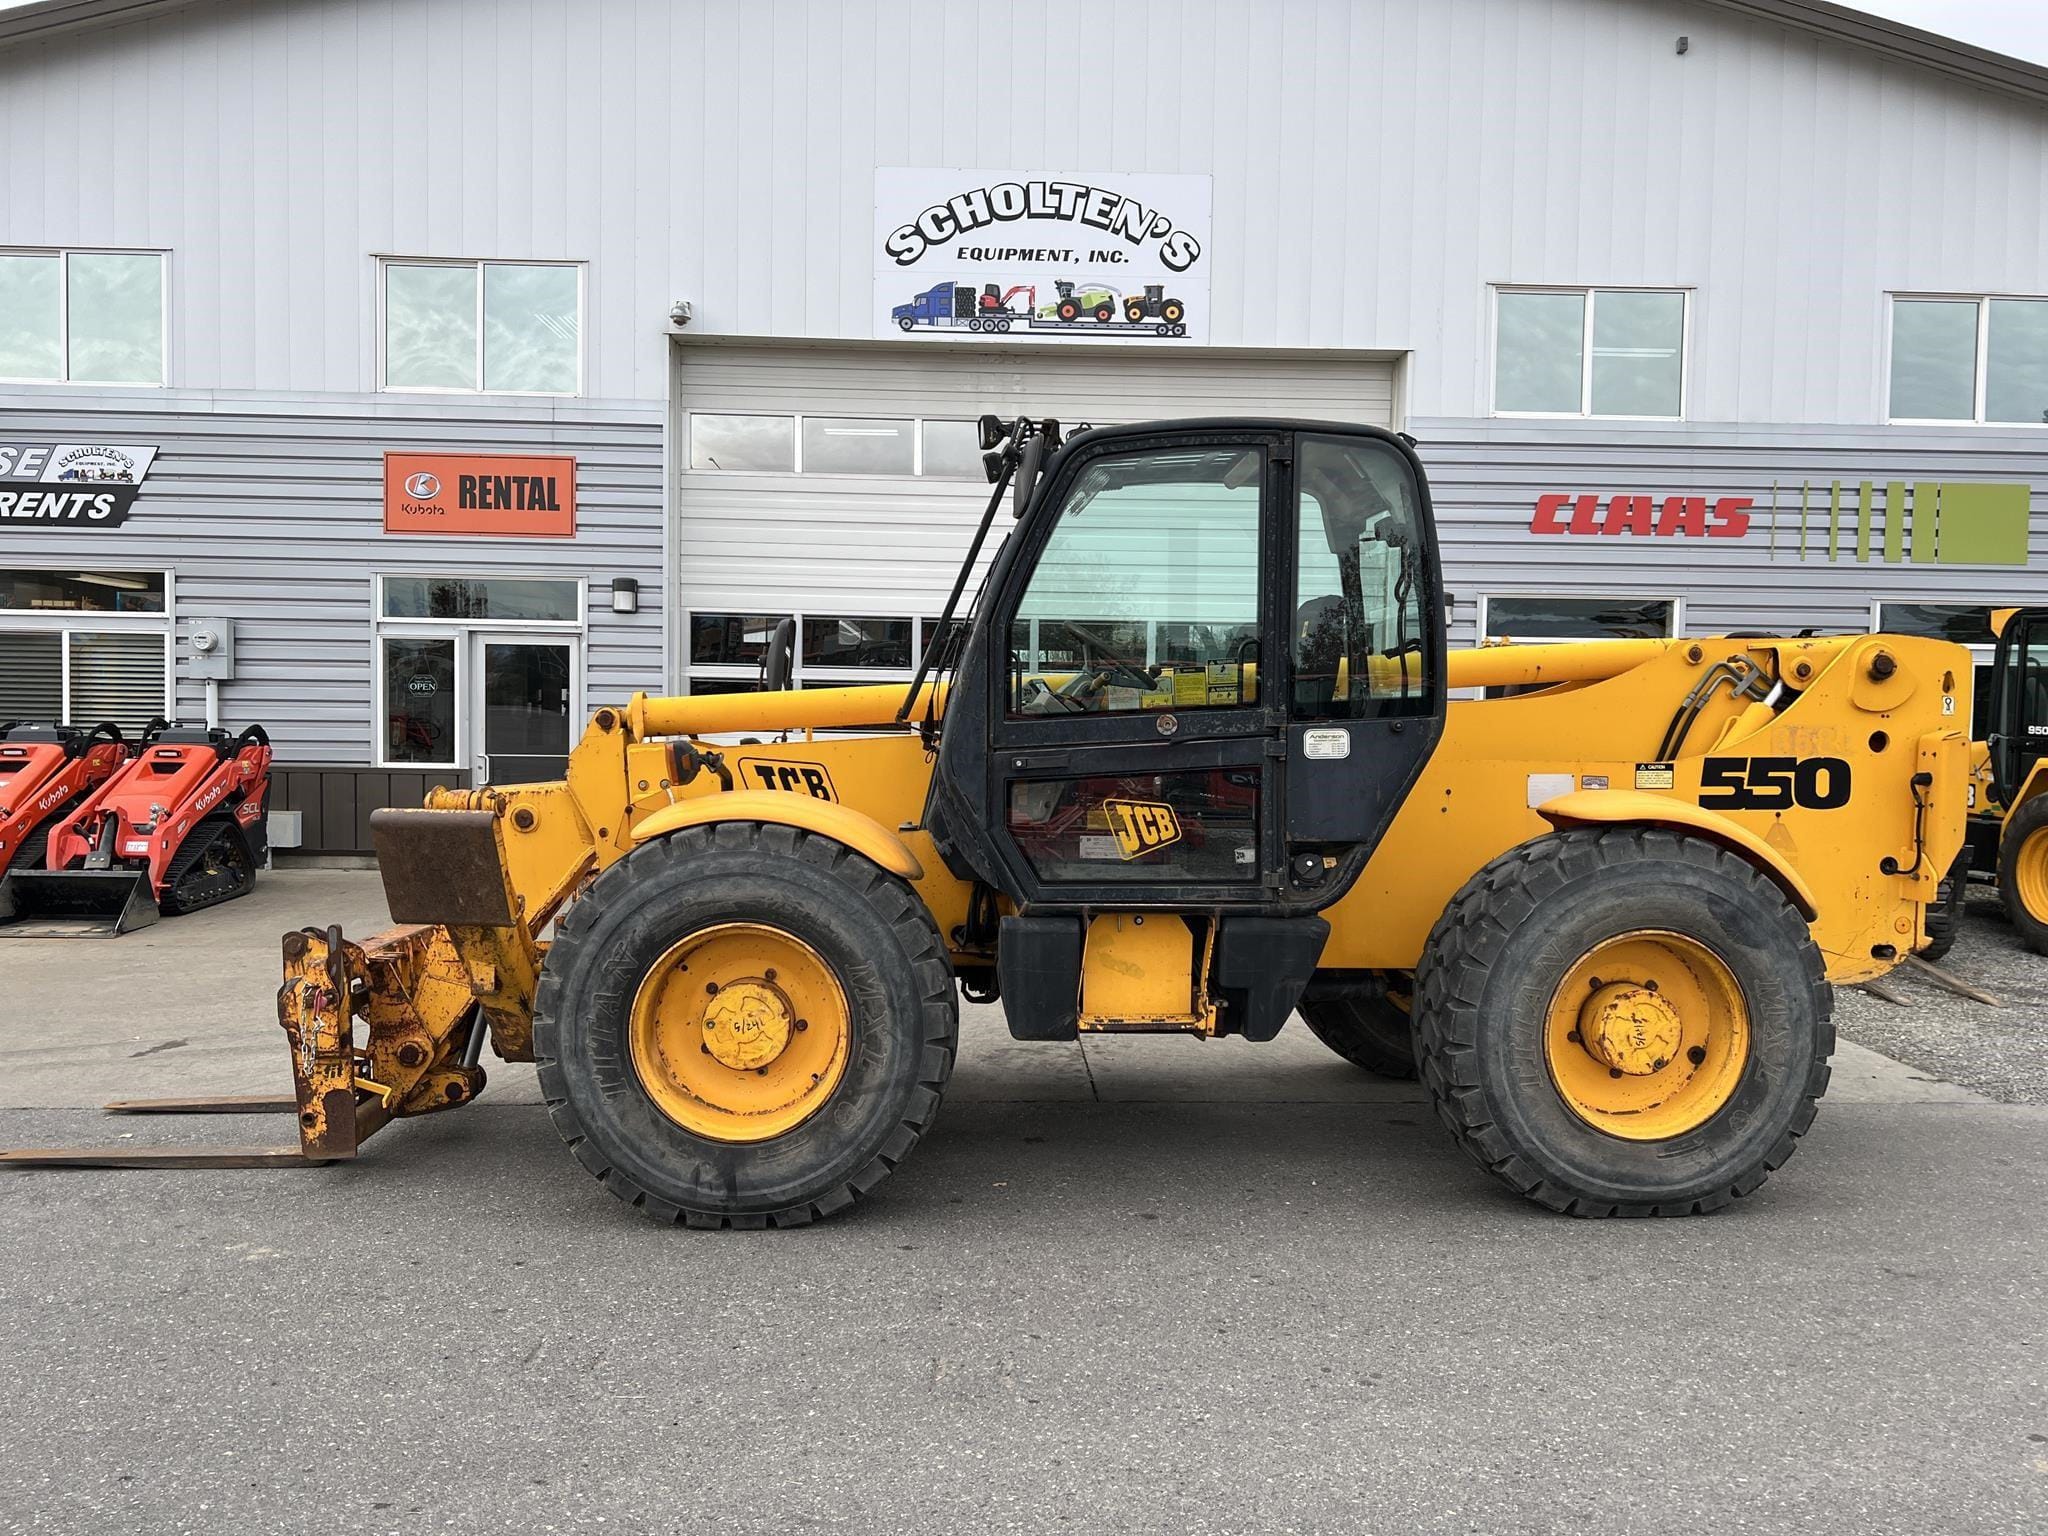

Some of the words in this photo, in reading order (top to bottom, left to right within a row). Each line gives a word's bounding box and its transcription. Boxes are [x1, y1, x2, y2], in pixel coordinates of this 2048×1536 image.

[885, 181, 1201, 272] SCHOLTEN'S
[957, 247, 1080, 265] EQUIPMENT,
[1088, 249, 1129, 264] INC.
[58, 446, 135, 468] SCHOLTEN'S
[458, 474, 561, 512] RENTAL
[401, 503, 445, 515] Kubota
[1529, 494, 1754, 537] CLAAS
[409, 682, 436, 691] OPEN
[1698, 756, 1852, 811] 550
[38, 784, 69, 810] Kubota
[194, 786, 221, 811] Kubota
[1115, 804, 1176, 854] JCB
